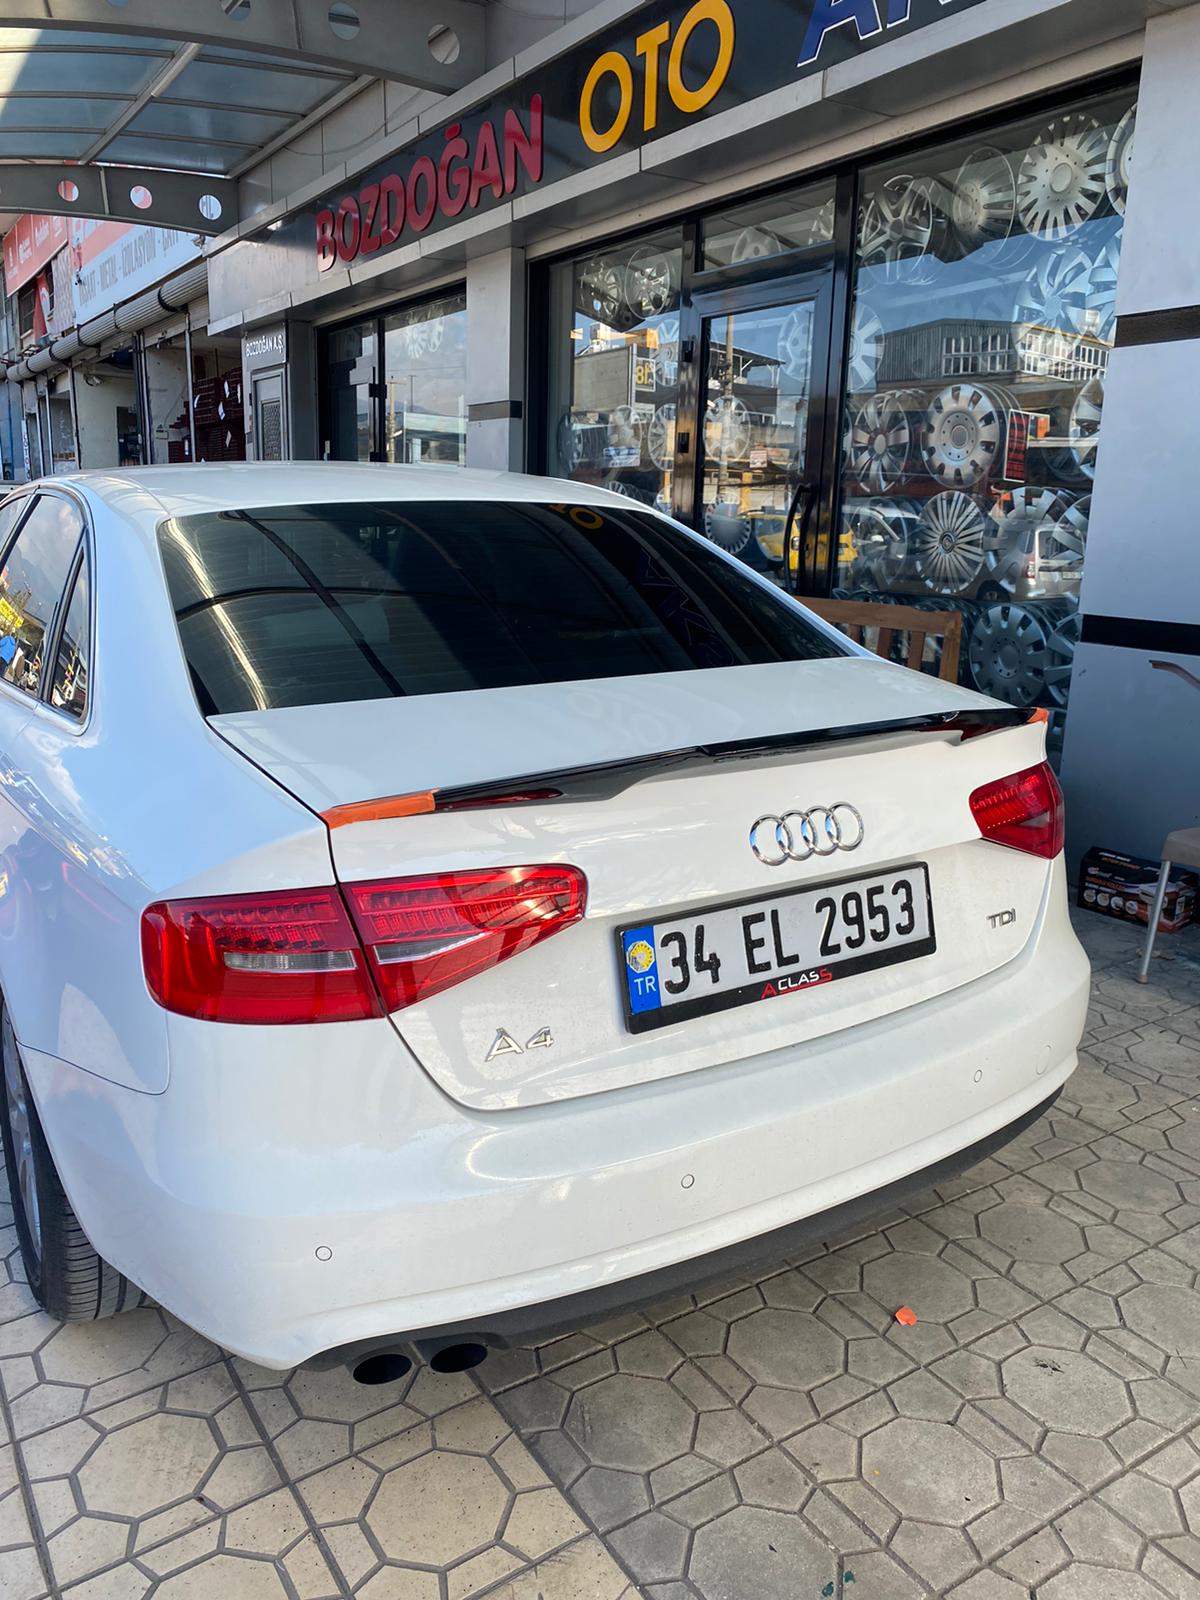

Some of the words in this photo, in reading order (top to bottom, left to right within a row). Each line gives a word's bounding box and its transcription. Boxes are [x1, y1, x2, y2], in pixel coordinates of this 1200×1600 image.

[316, 94, 543, 272] BOZDOĞAN
[579, 0, 735, 153] OTO
[797, 0, 957, 67] A
[246, 335, 273, 357] BOZDOĞAN
[986, 908, 1016, 929] TDI
[660, 924, 721, 995] 34
[741, 909, 800, 974] EL
[815, 879, 914, 956] 2953
[633, 975, 657, 996] TR
[484, 1026, 554, 1062] A4
